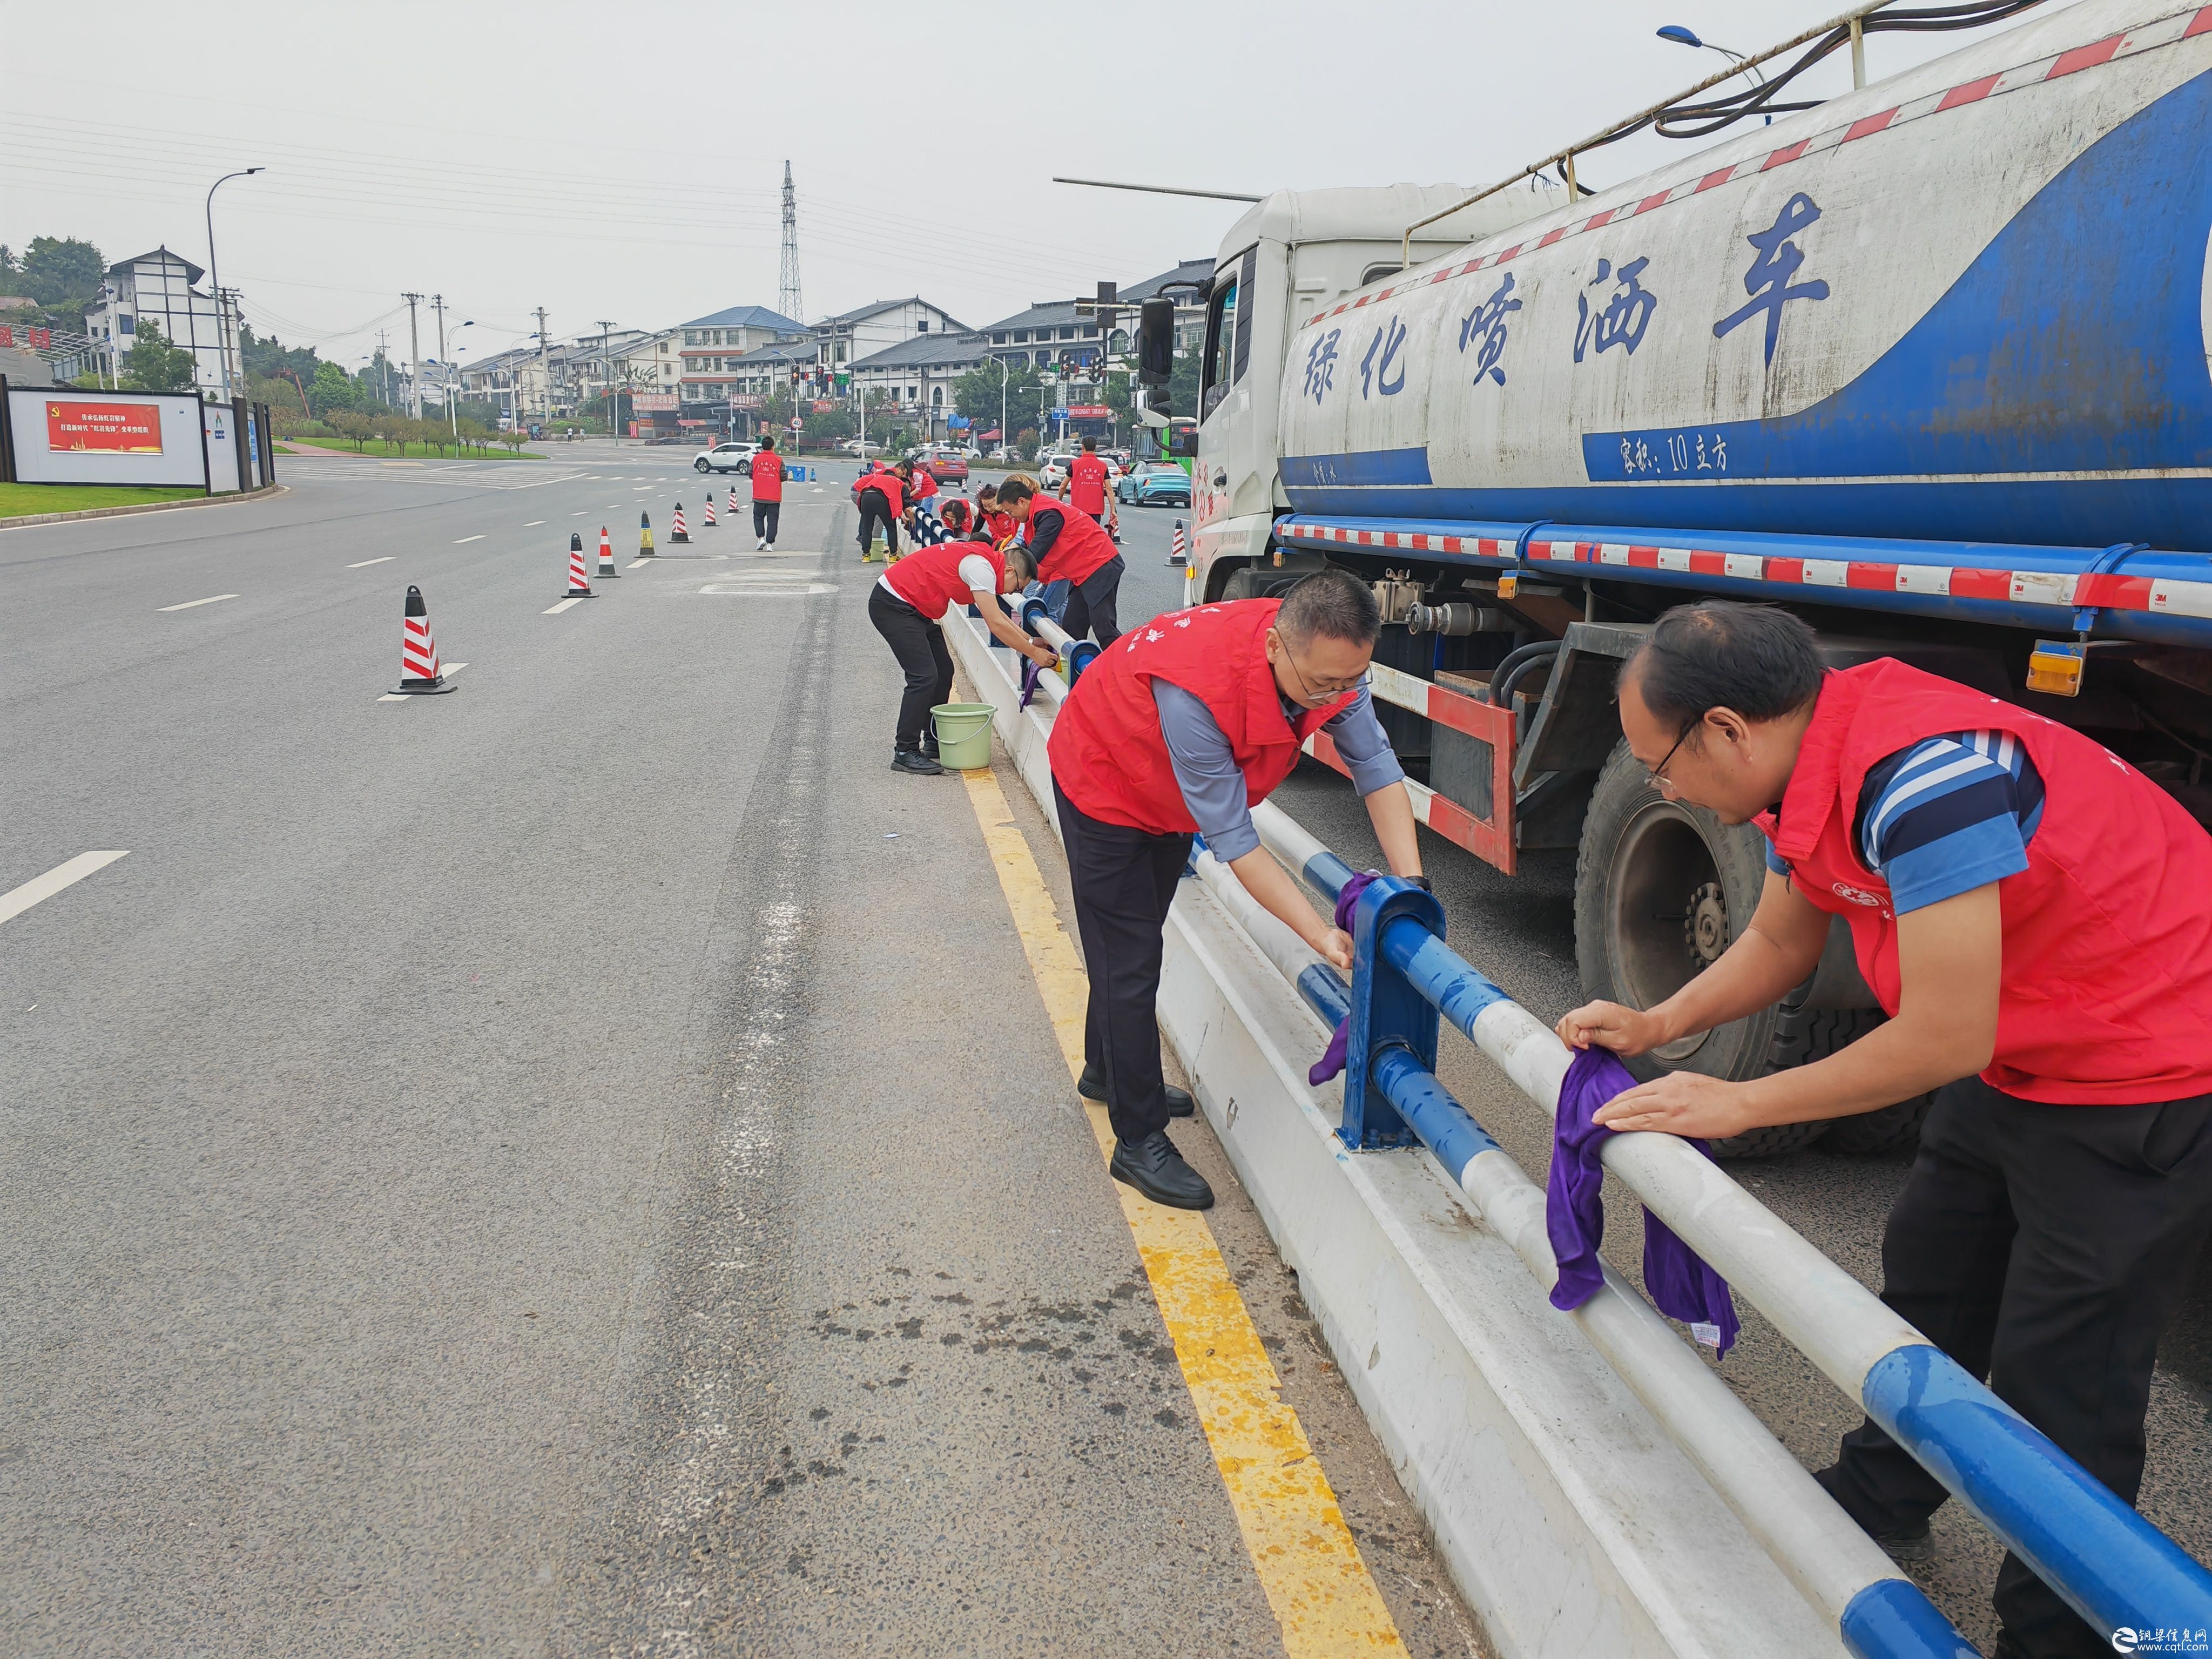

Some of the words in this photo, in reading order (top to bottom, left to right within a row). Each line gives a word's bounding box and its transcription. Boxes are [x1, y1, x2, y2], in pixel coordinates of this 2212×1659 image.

[1303, 192, 1830, 407] 绿化喷洒车
[82, 414, 126, 422] 传承弘扬红岩精神
[2155, 594, 2167, 602] 3M
